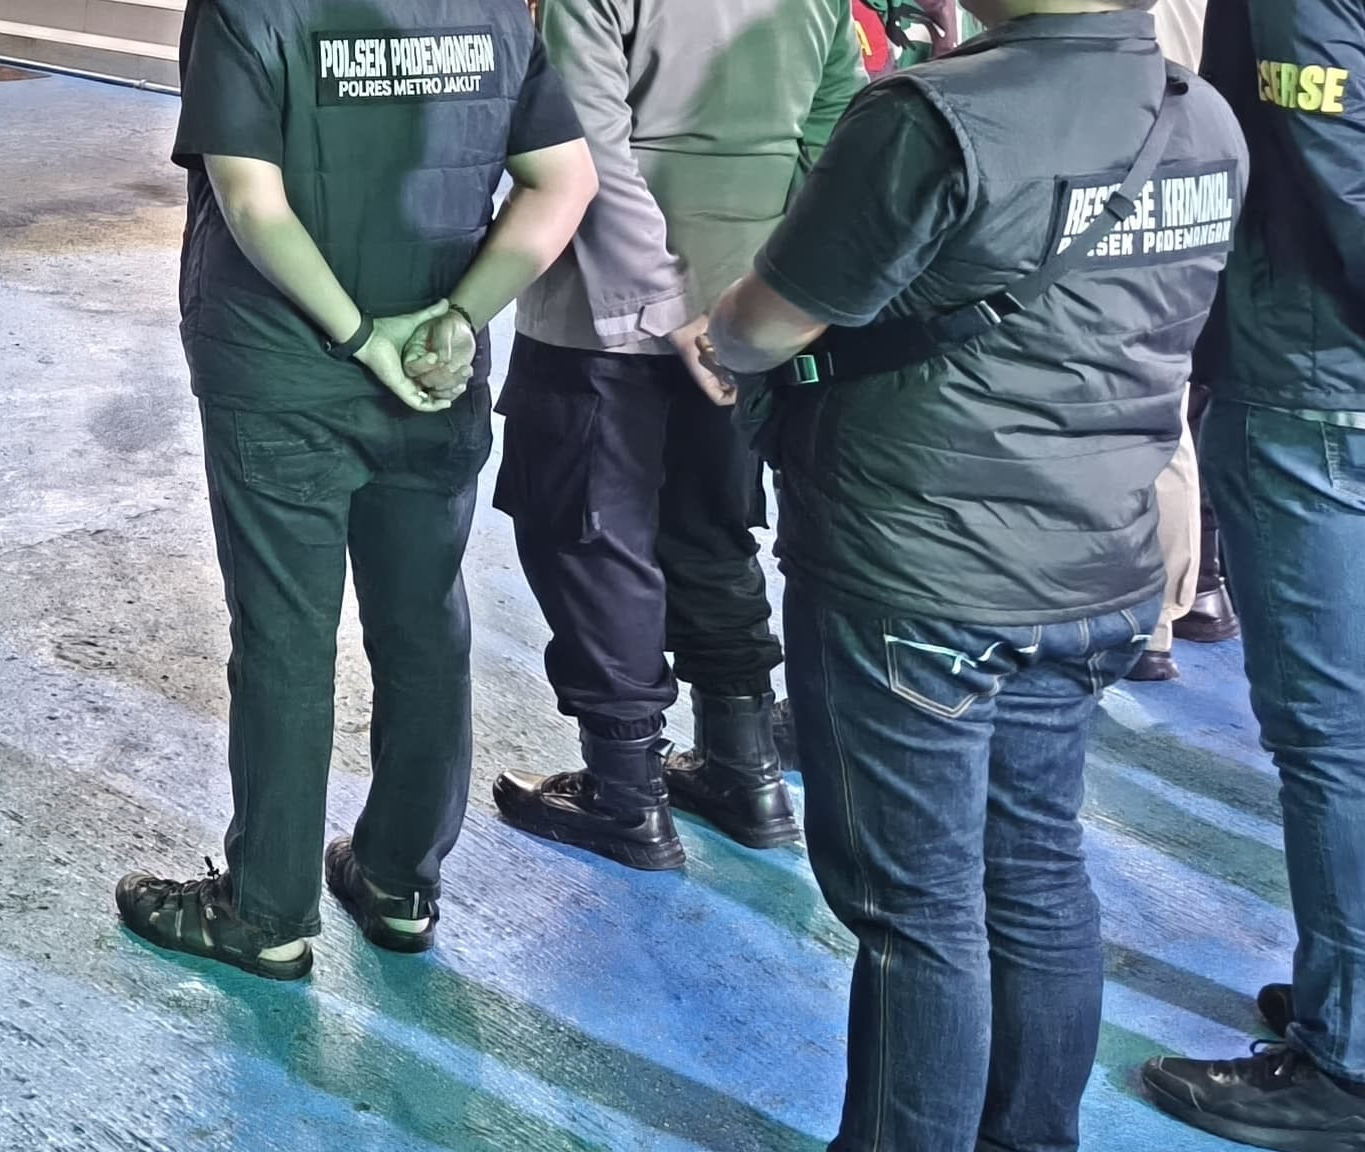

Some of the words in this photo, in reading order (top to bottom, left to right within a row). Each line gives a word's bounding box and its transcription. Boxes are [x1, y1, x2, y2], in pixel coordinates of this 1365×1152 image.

[320, 39, 387, 78] POLSEK
[390, 34, 495, 76] PADEMANGAN
[339, 79, 392, 97] POLRES
[393, 78, 442, 96] METRO
[443, 75, 482, 93] JAKUT
[1161, 171, 1232, 228] KRIMINAL
[1057, 232, 1133, 257] PSEK
